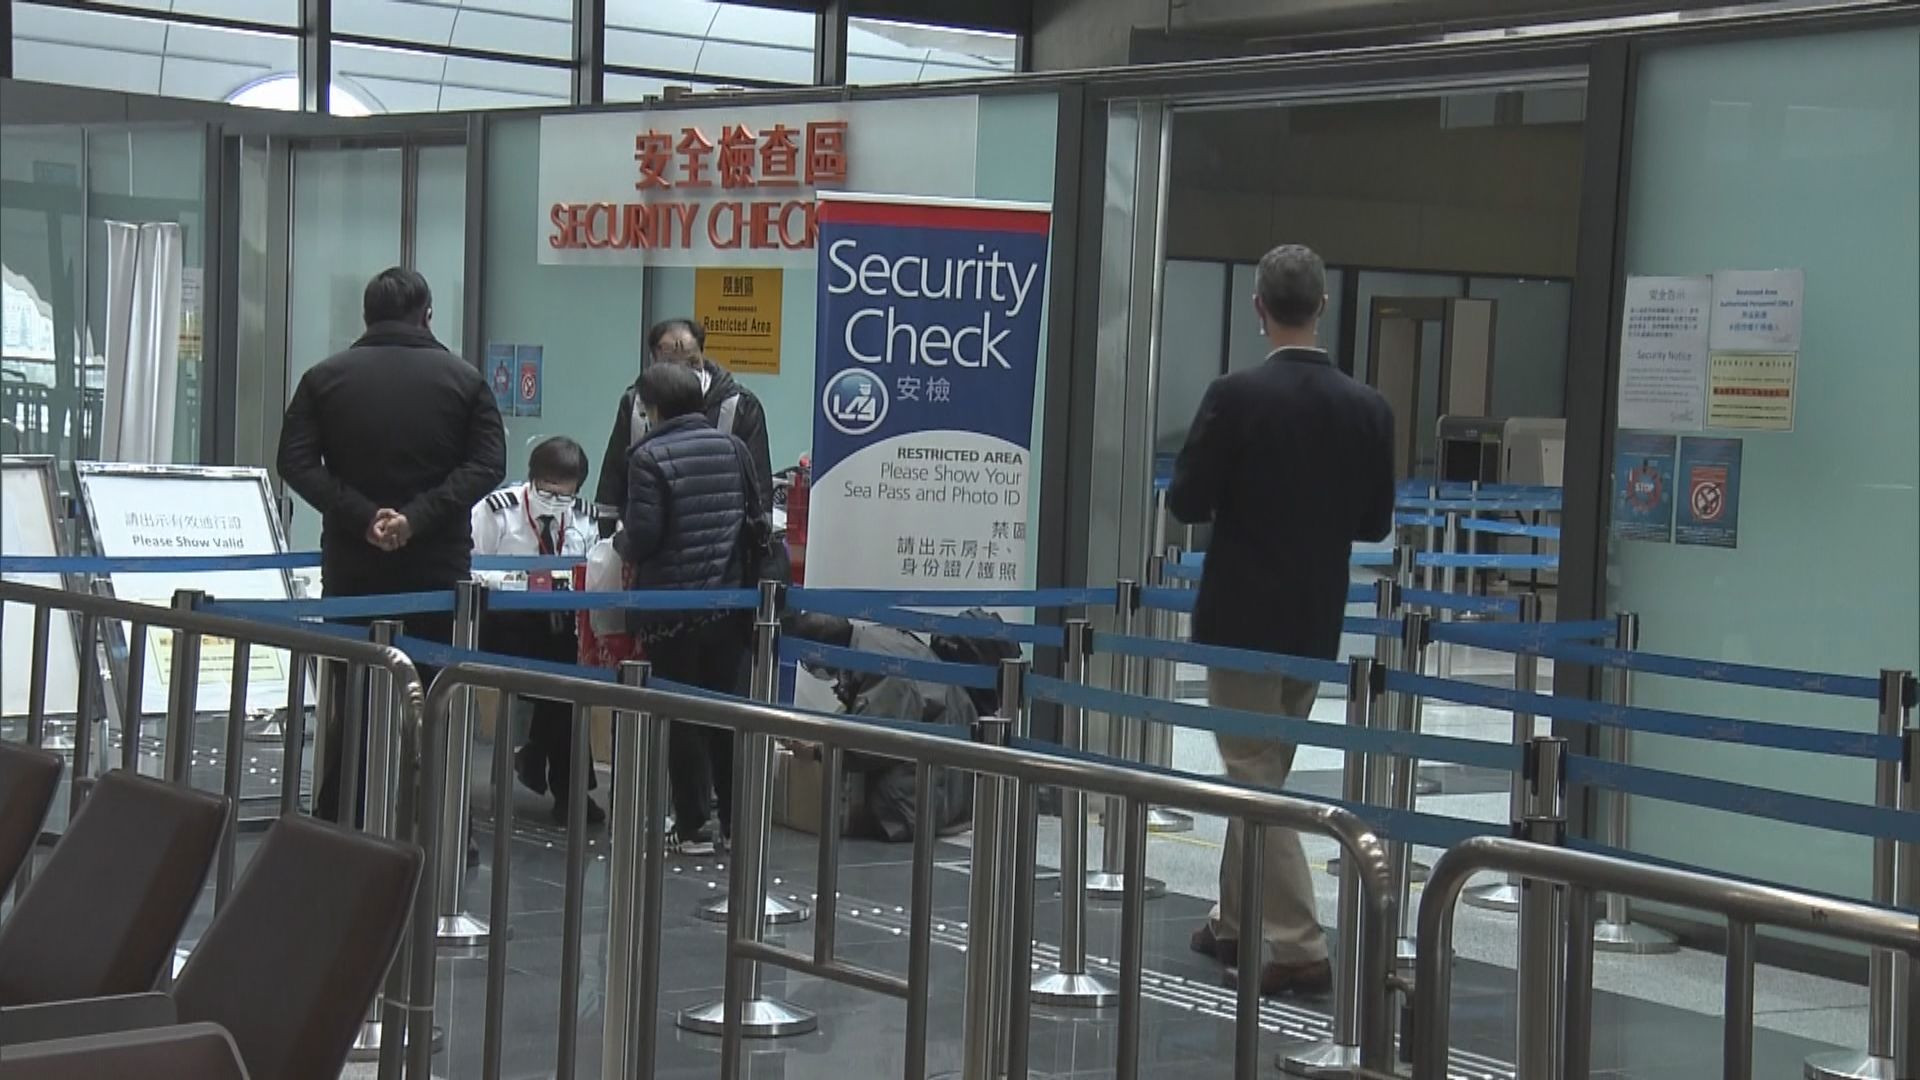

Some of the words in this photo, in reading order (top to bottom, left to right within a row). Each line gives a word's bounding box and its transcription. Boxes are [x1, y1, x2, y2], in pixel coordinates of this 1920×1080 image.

[635, 122, 848, 190] 安全檢查區
[549, 203, 700, 249] SECURITY
[828, 237, 1038, 318] Security
[704, 316, 747, 331] Restricted
[751, 318, 771, 333] Area
[845, 306, 1011, 369] Check
[896, 376, 950, 402] 安檢
[897, 447, 979, 463] RESTRICTED
[984, 451, 1023, 465] AREA
[881, 462, 928, 480] Please
[934, 464, 980, 484] Show
[985, 467, 1021, 486] Your
[844, 482, 872, 498] Sea
[878, 484, 910, 501] Pass
[916, 484, 946, 502] and
[952, 486, 998, 505] Photo
[1004, 489, 1021, 506] ID
[132, 534, 173, 547] Please
[175, 535, 209, 548] Show
[212, 537, 244, 549] Valid
[992, 520, 1026, 540] 禁區
[901, 557, 1017, 581] 身份證/護照
